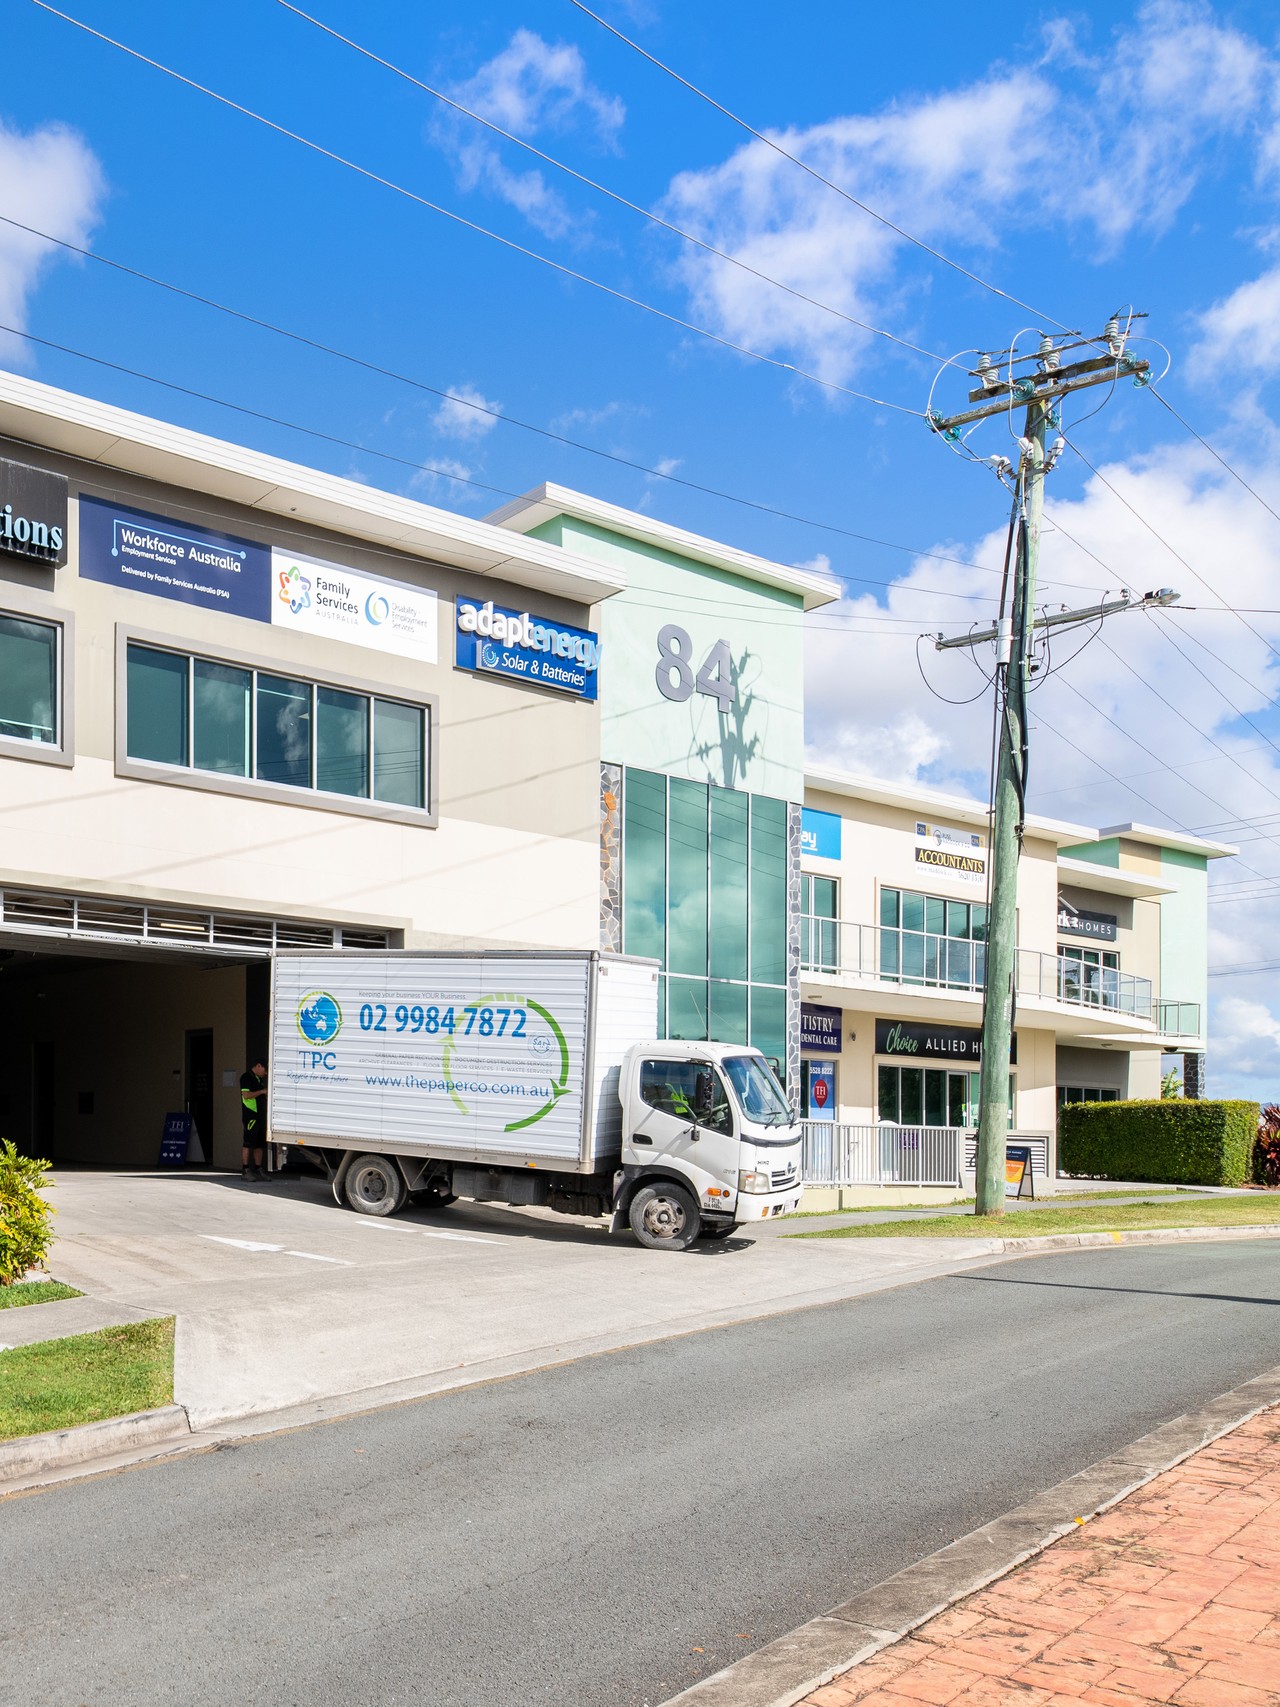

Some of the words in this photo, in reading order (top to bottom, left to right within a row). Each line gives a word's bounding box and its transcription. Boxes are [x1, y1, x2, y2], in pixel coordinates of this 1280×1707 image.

[121, 529, 185, 557] Workforce
[189, 547, 241, 572] Australia
[121, 545, 154, 560] Employment
[155, 554, 176, 565] Services
[121, 565, 146, 578] Delivered
[147, 570, 154, 580] by
[155, 573, 172, 586] Family
[173, 578, 193, 589] Services
[194, 583, 215, 595] Australia
[216, 589, 230, 599] (FSA)
[316, 577, 350, 598] Family
[316, 593, 358, 614] Services
[392, 602, 418, 617] Disability
[316, 609, 359, 625] AUSTRALIA
[392, 611, 428, 628] Employment
[392, 620, 415, 633] Services
[458, 601, 603, 670] adaptenergy
[502, 653, 529, 672] Solar
[530, 660, 539, 675] &
[542, 663, 585, 687] Batteries
[656, 624, 735, 714] 84
[918, 849, 983, 873] ACCOUNTANTS
[1078, 922, 1111, 935] HOMES
[395, 991, 421, 999] business
[359, 1003, 387, 1032] 02
[394, 1005, 456, 1035] 9984
[463, 1007, 527, 1038] 7872
[802, 1014, 834, 1033] TISTRY
[801, 1033, 822, 1044] DENTAL
[823, 1035, 838, 1046] CARE
[886, 1023, 918, 1053] Choice
[925, 1038, 967, 1052] ALLIED
[299, 1050, 336, 1071] TPC
[486, 1057, 525, 1065] DESTRUCTION
[526, 1067, 553, 1075] SERVICES
[365, 1075, 549, 1097] www.thepaperco.com.au
[815, 1085, 826, 1095] TFI
[171, 1121, 184, 1129] TFI
